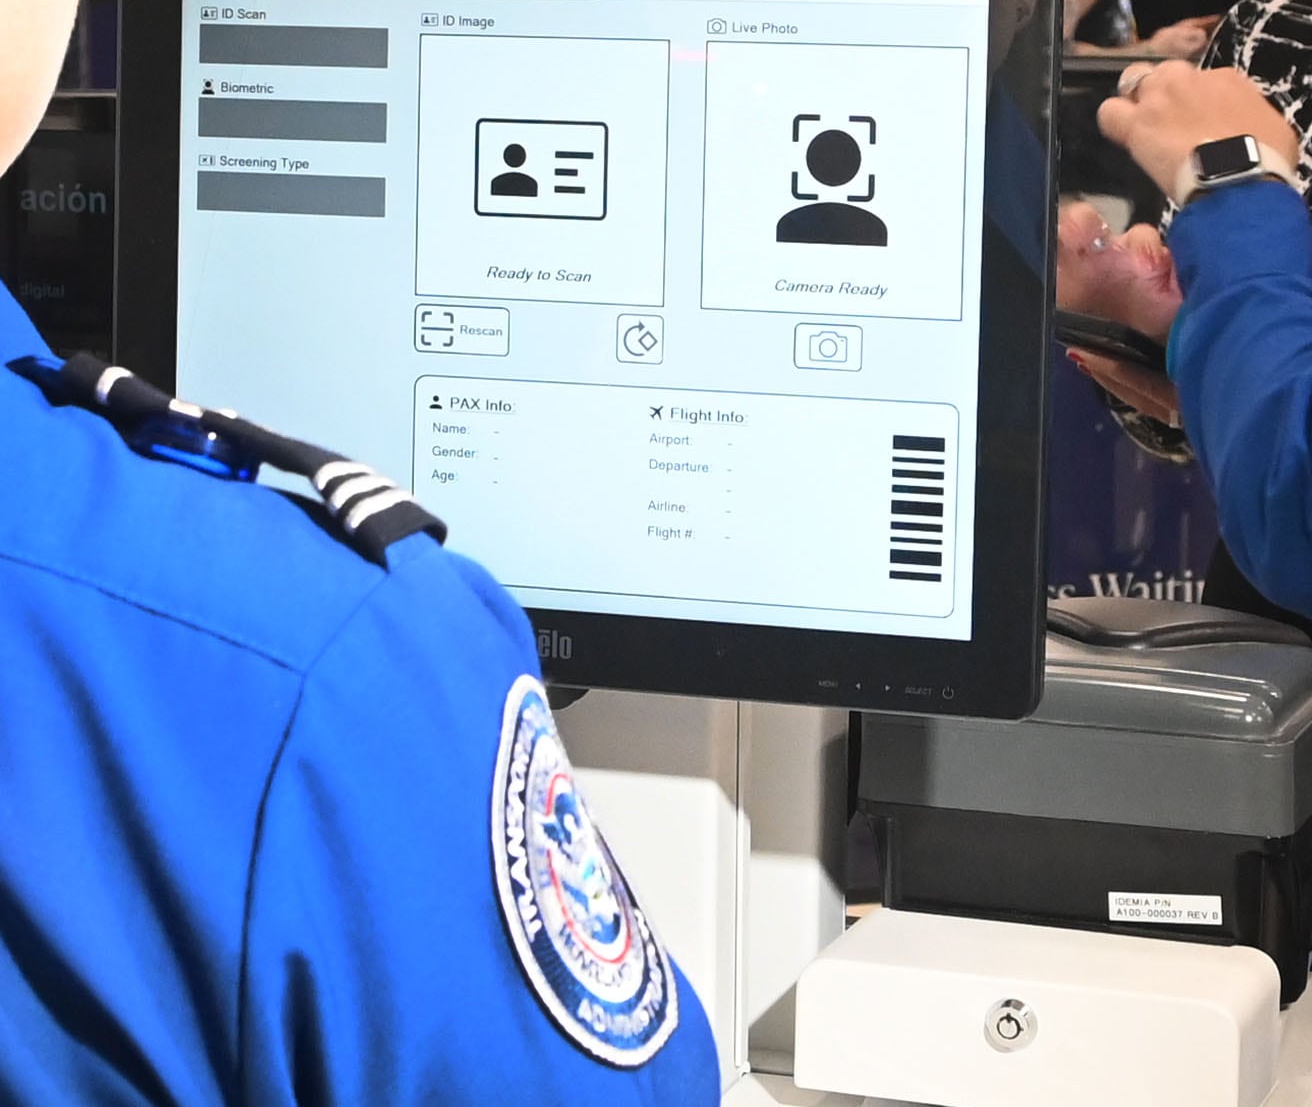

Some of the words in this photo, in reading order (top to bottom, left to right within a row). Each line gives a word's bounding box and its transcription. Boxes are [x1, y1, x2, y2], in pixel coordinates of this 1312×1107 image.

[221, 9, 234, 19] ID
[237, 9, 266, 20] Scan
[442, 15, 455, 26] ID
[459, 16, 495, 30] Image
[732, 22, 758, 33] Live
[762, 22, 799, 35] Photo
[220, 81, 275, 94] Biometric
[219, 155, 278, 171] Screening
[281, 157, 310, 171] Type
[486, 266, 533, 284] Ready
[537, 268, 551, 282] to
[555, 269, 592, 284] Scan
[774, 278, 833, 295] Camera
[838, 281, 888, 299] Ready
[459, 324, 503, 338] Rescan
[450, 397, 480, 411] PAX
[670, 407, 712, 425] Flight
[647, 525, 682, 541] Flight
[1115, 897, 1150, 906] IDEMIA
[1187, 911, 1208, 920] REV
